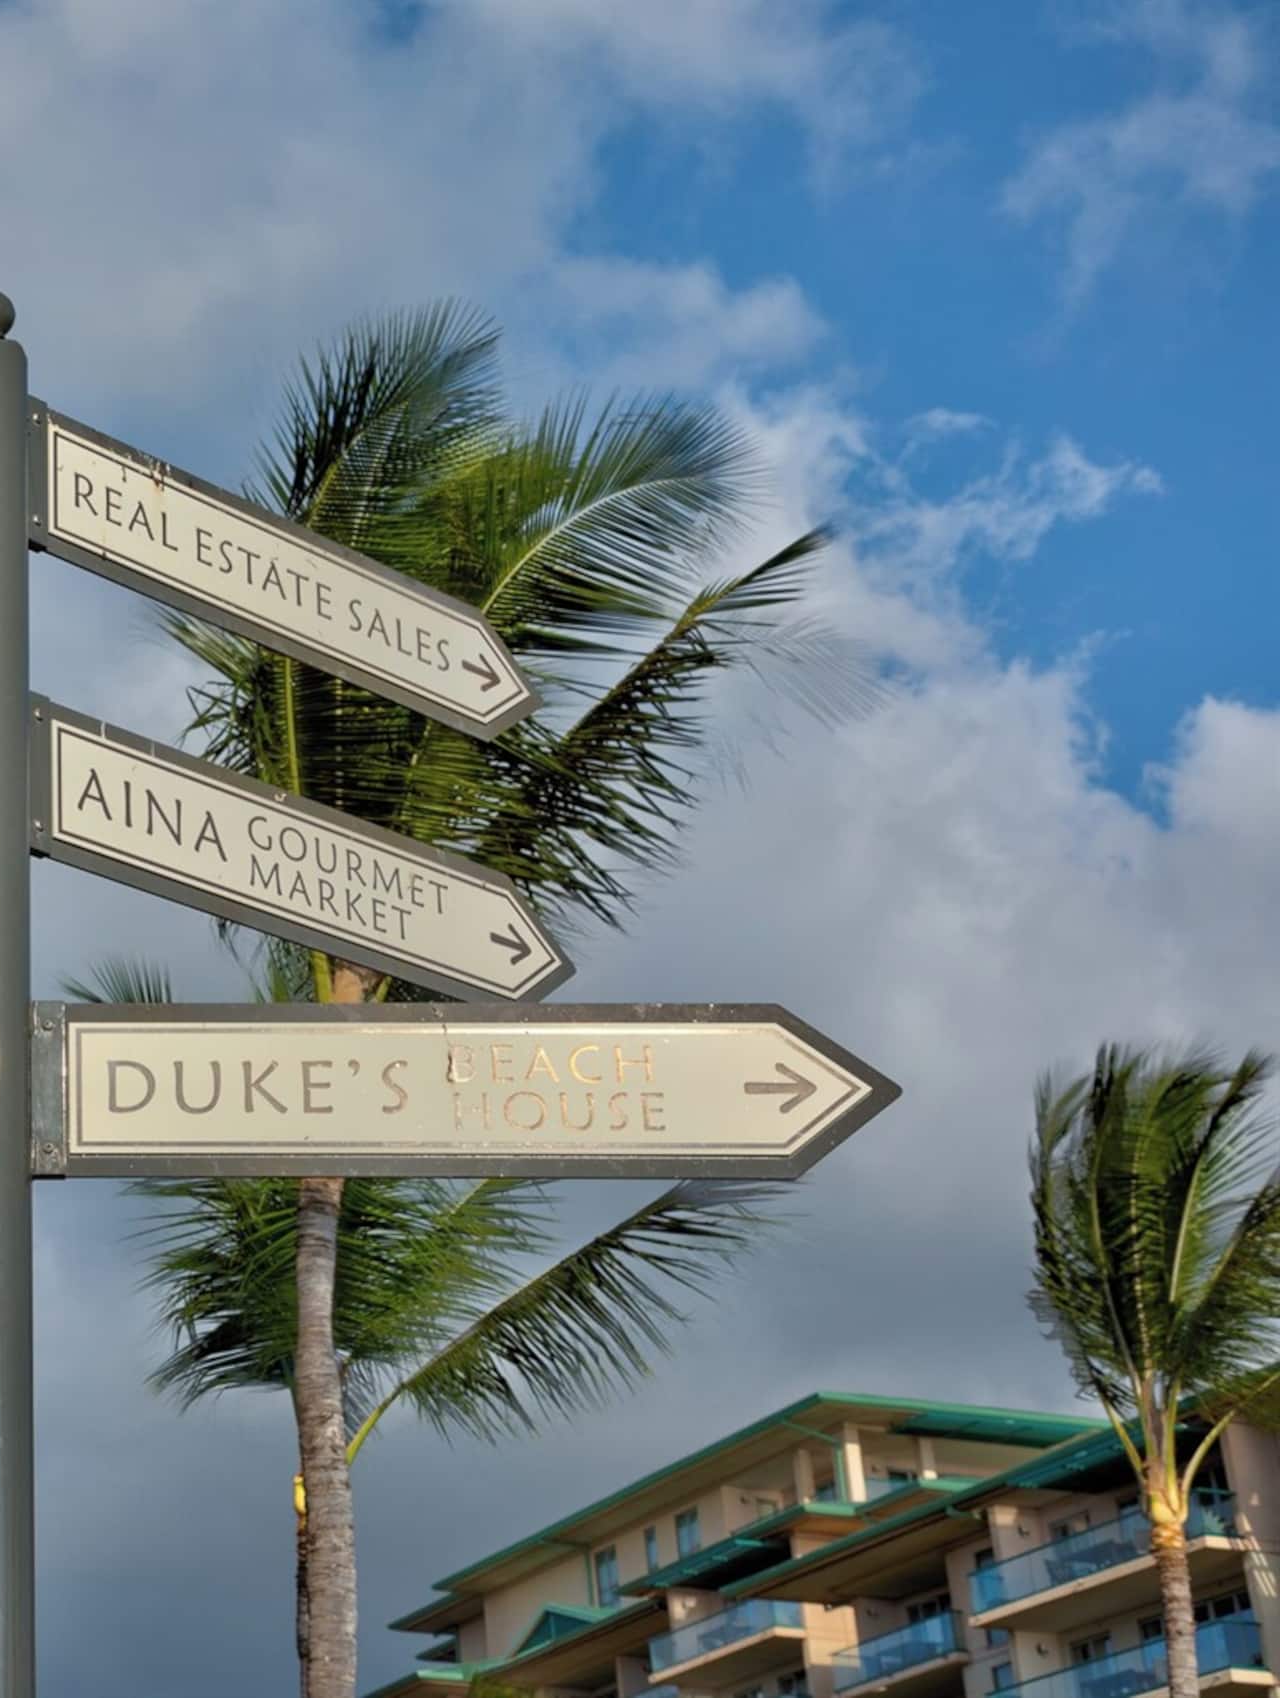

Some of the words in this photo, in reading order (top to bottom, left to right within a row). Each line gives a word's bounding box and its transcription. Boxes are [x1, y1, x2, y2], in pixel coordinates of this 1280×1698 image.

[73, 471, 179, 553] REAL
[196, 527, 333, 622] ESTATE
[348, 599, 451, 673] SALES
[76, 768, 228, 863] AINA
[247, 815, 449, 915] GOURMET
[249, 854, 412, 941] MARKET
[447, 1043, 655, 1085] BEACH
[451, 1090, 667, 1133] HOUSE
